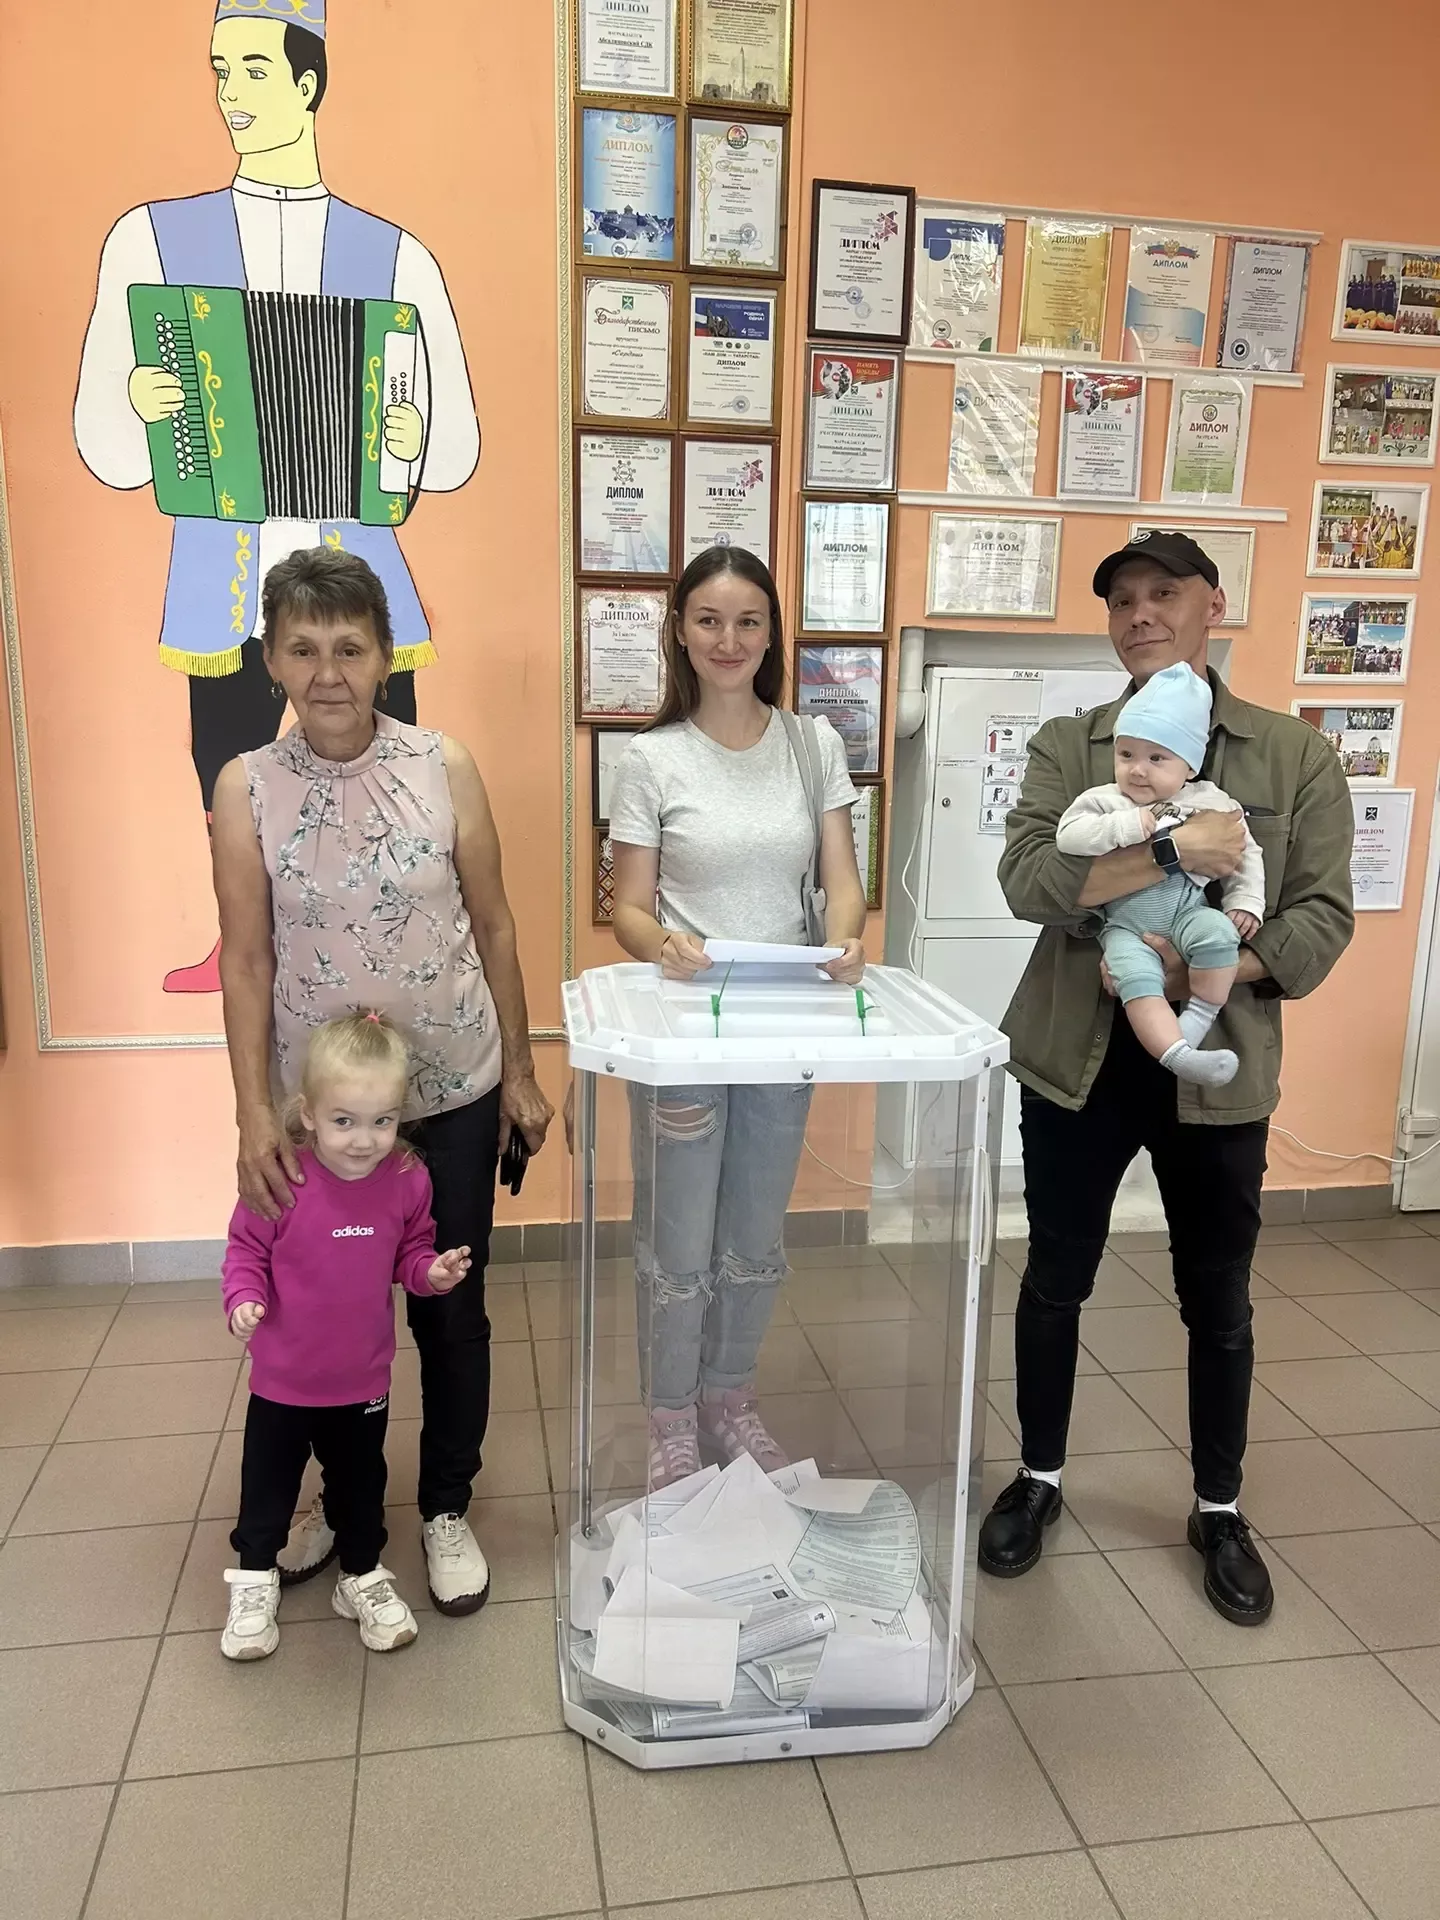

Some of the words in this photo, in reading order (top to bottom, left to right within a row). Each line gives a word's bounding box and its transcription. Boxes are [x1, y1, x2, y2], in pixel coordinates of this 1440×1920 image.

[602, 1, 649, 14] ДИПЛОМ
[602, 140, 653, 153] ДИПЛОМ
[840, 239, 880, 250] ДИПЛОМ
[1051, 235, 1087, 245] ДИПЛОМ
[1153, 259, 1188, 269] ДИПЛОМ
[1253, 267, 1282, 275] ДИПЛОМ
[594, 307, 657, 326] Благодарственное
[717, 359, 746, 367] ДИПЛОМ
[830, 407, 873, 416] ДИПЛОМ
[1081, 422, 1121, 431] ДИПЛОМ
[1189, 423, 1228, 433] ДИПЛОМ
[606, 487, 643, 499] ДИПЛОМ
[706, 488, 746, 497] ДИПЛОМ
[823, 543, 867, 552] ДИПЛОМ
[972, 543, 1019, 551] ДИПЛОМ
[600, 611, 649, 621] ДИПЛОМ
[819, 688, 860, 697] ДИПЛОМ
[332, 1226, 374, 1238] adidas
